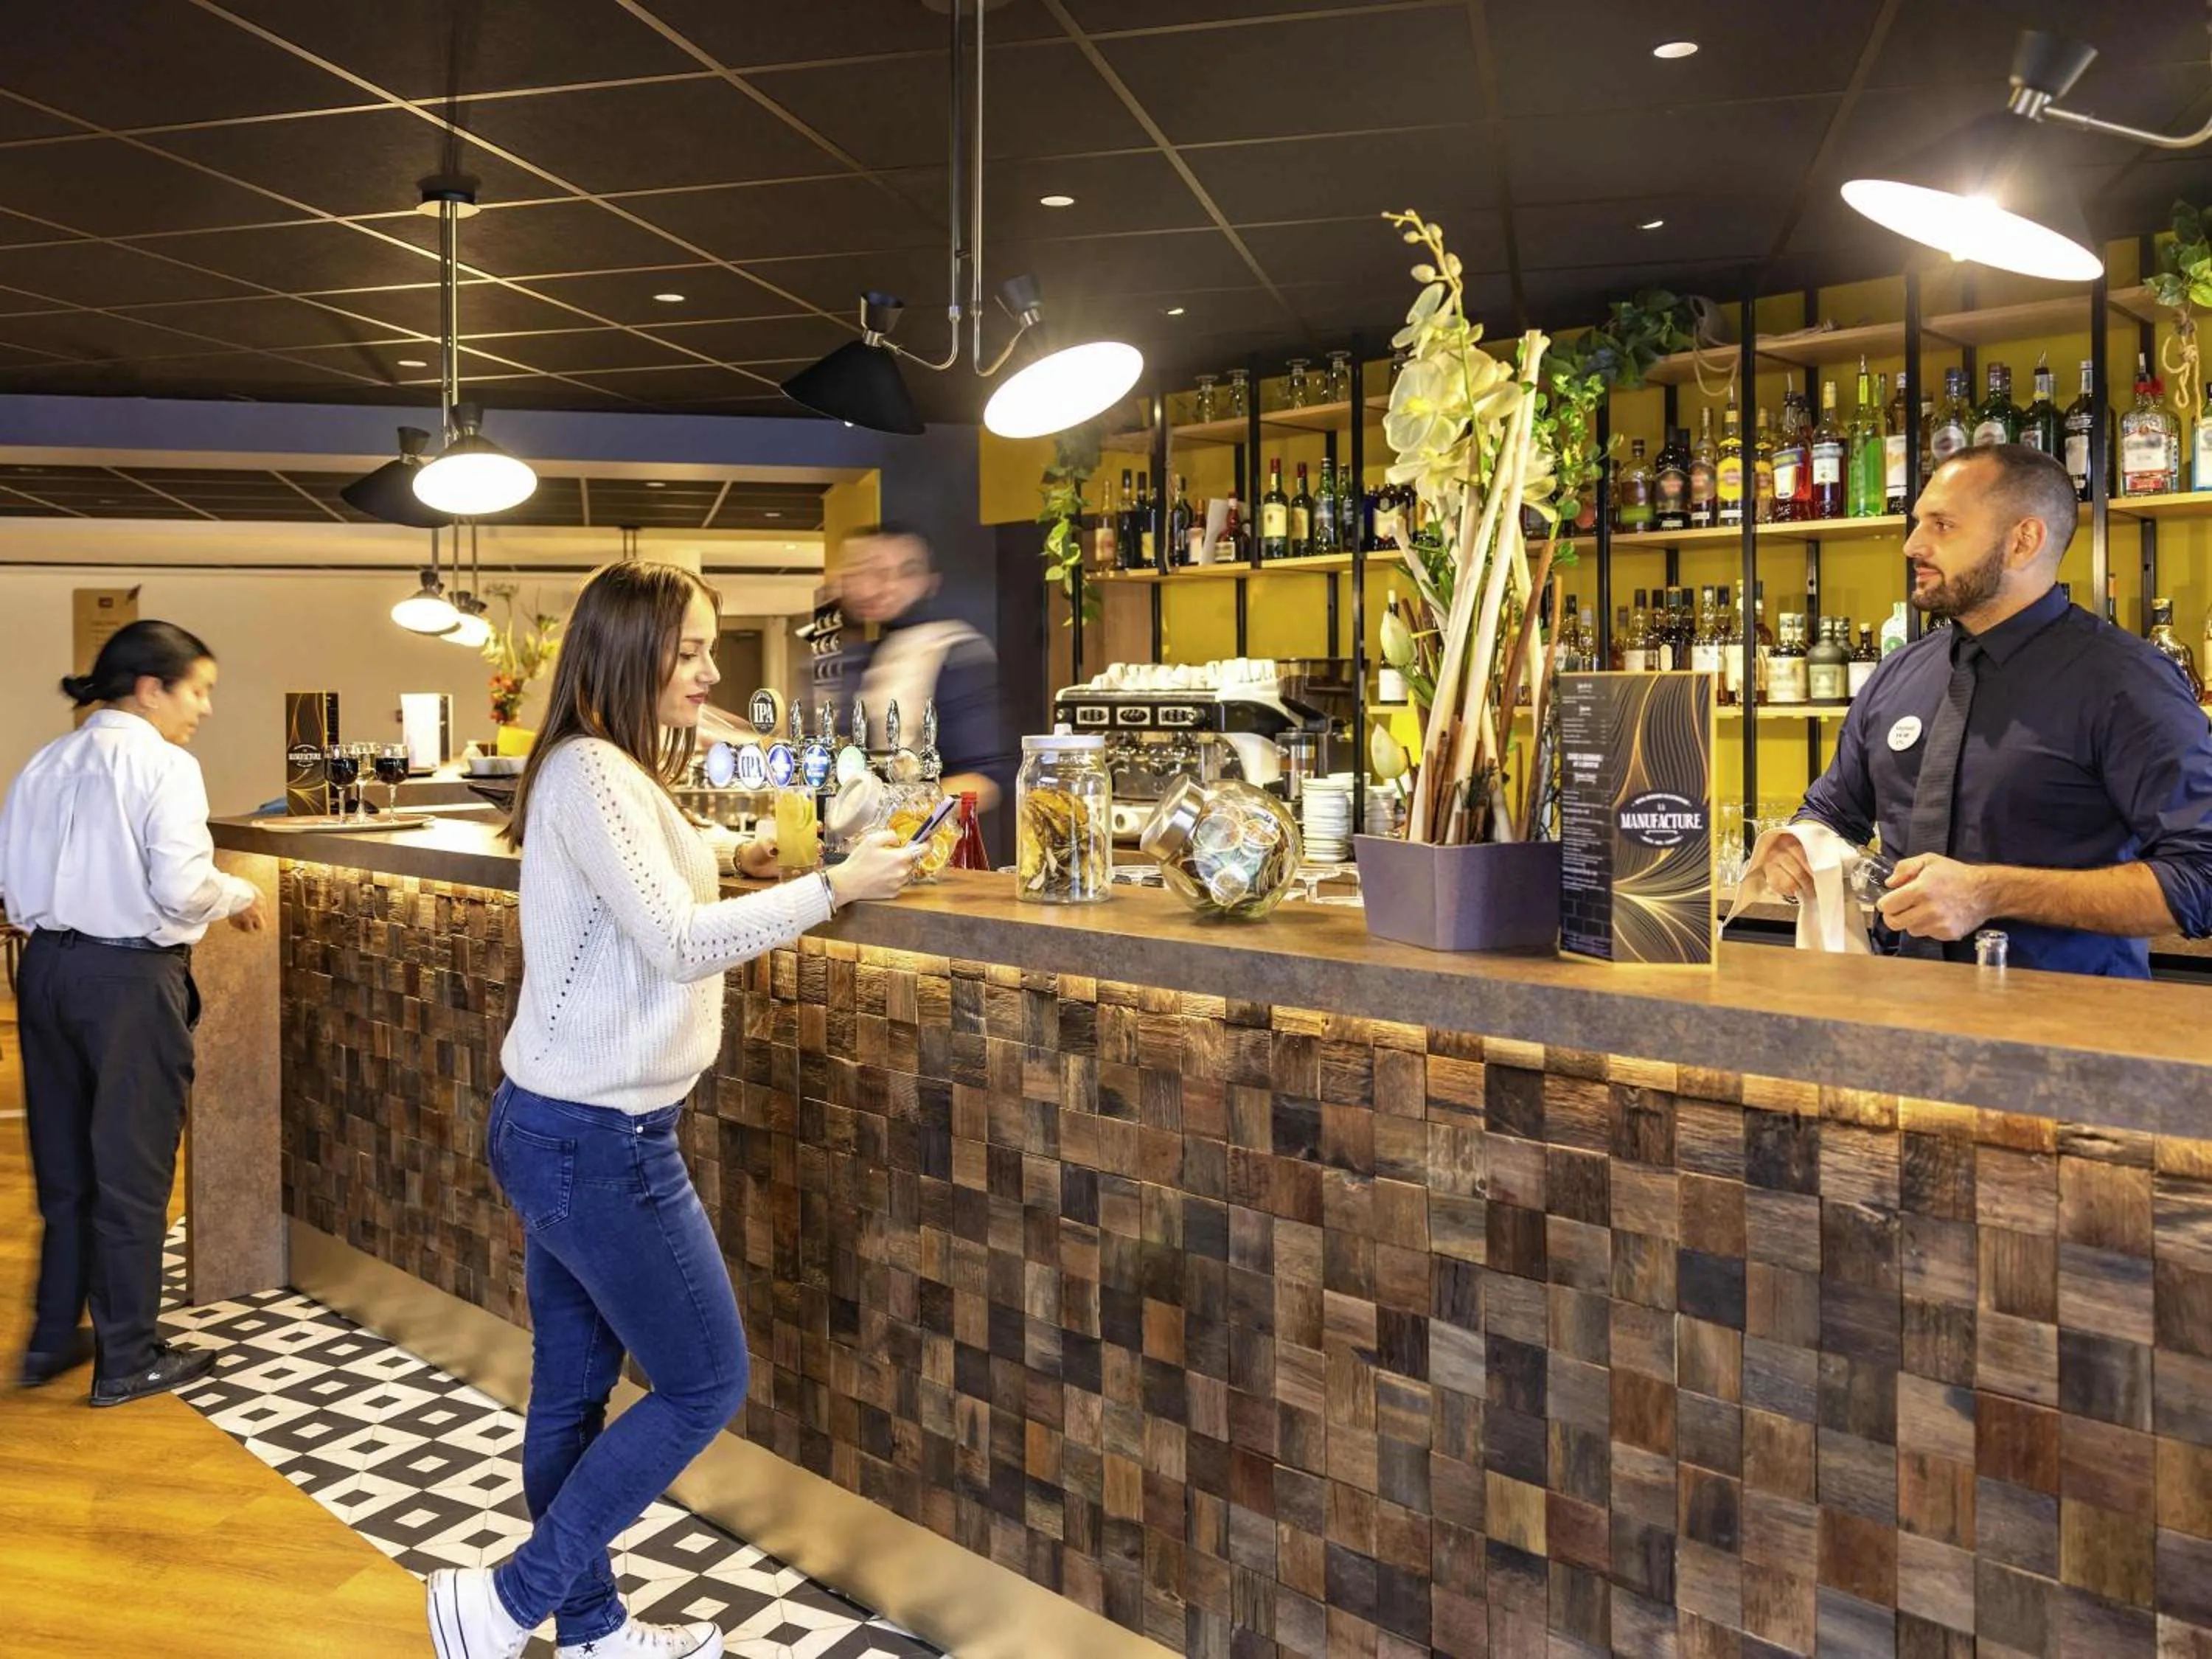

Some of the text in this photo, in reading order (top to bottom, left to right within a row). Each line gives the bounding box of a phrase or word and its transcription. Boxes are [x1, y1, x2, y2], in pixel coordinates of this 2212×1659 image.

[753, 703, 774, 723] IPA
[741, 756, 762, 779] IPA
[1621, 813, 1703, 829] MANUFACTURE
